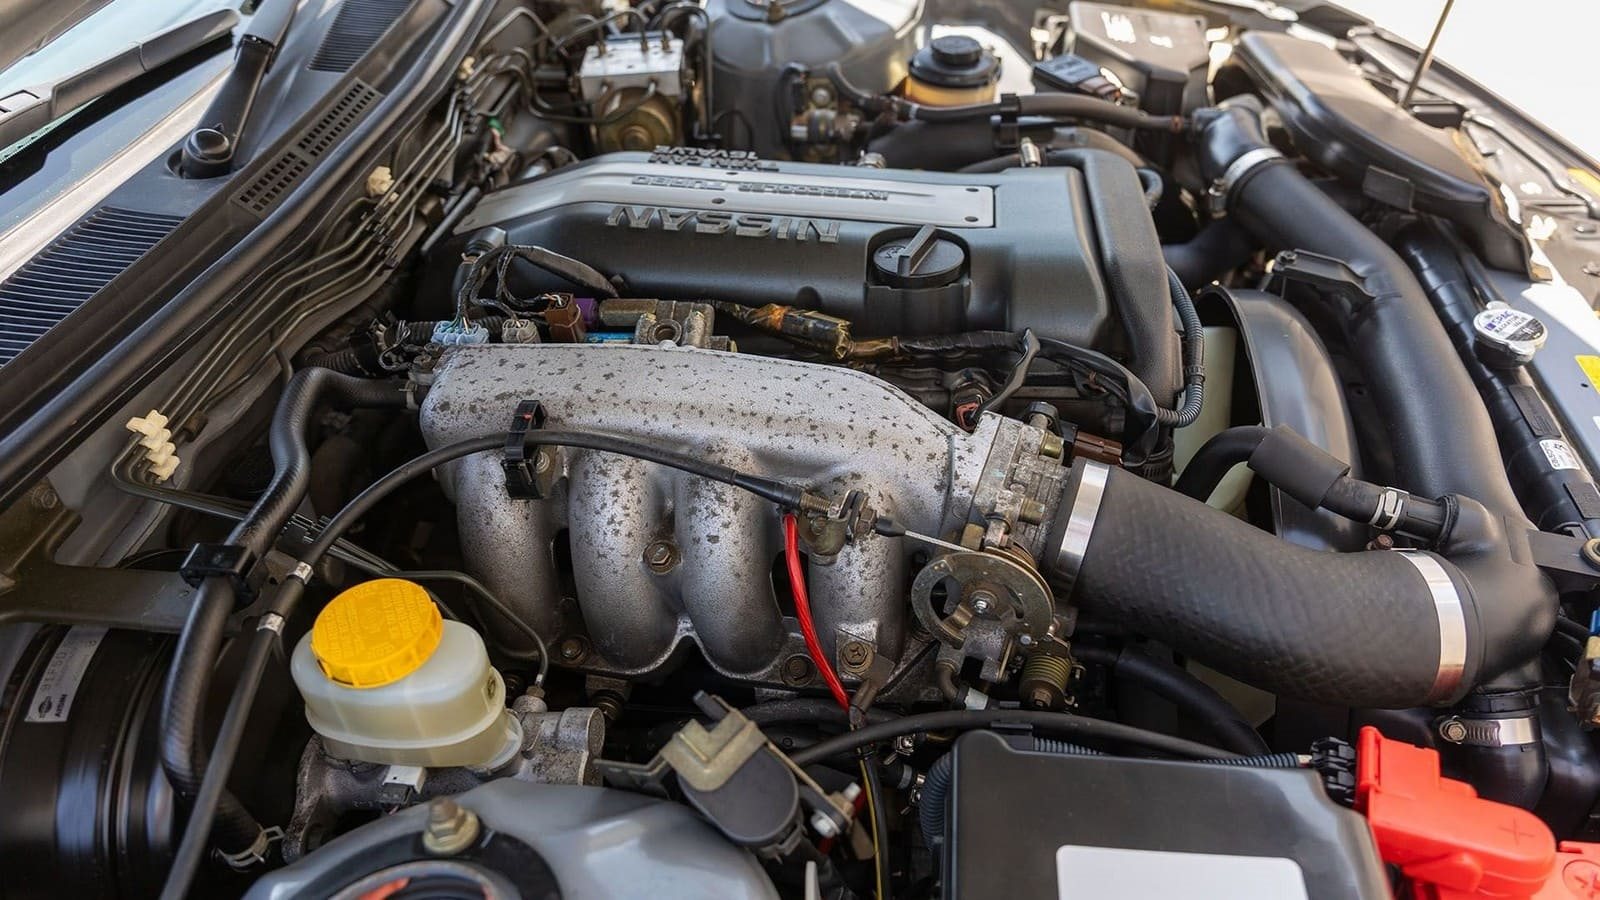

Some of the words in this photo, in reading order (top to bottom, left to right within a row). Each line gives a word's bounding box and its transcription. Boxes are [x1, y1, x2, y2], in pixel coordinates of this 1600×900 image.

[648, 153, 703, 167] CAM
[632, 176, 727, 190] TURBO
[739, 182, 888, 200] INTERCOOLER
[605, 206, 840, 243] NISSAN
